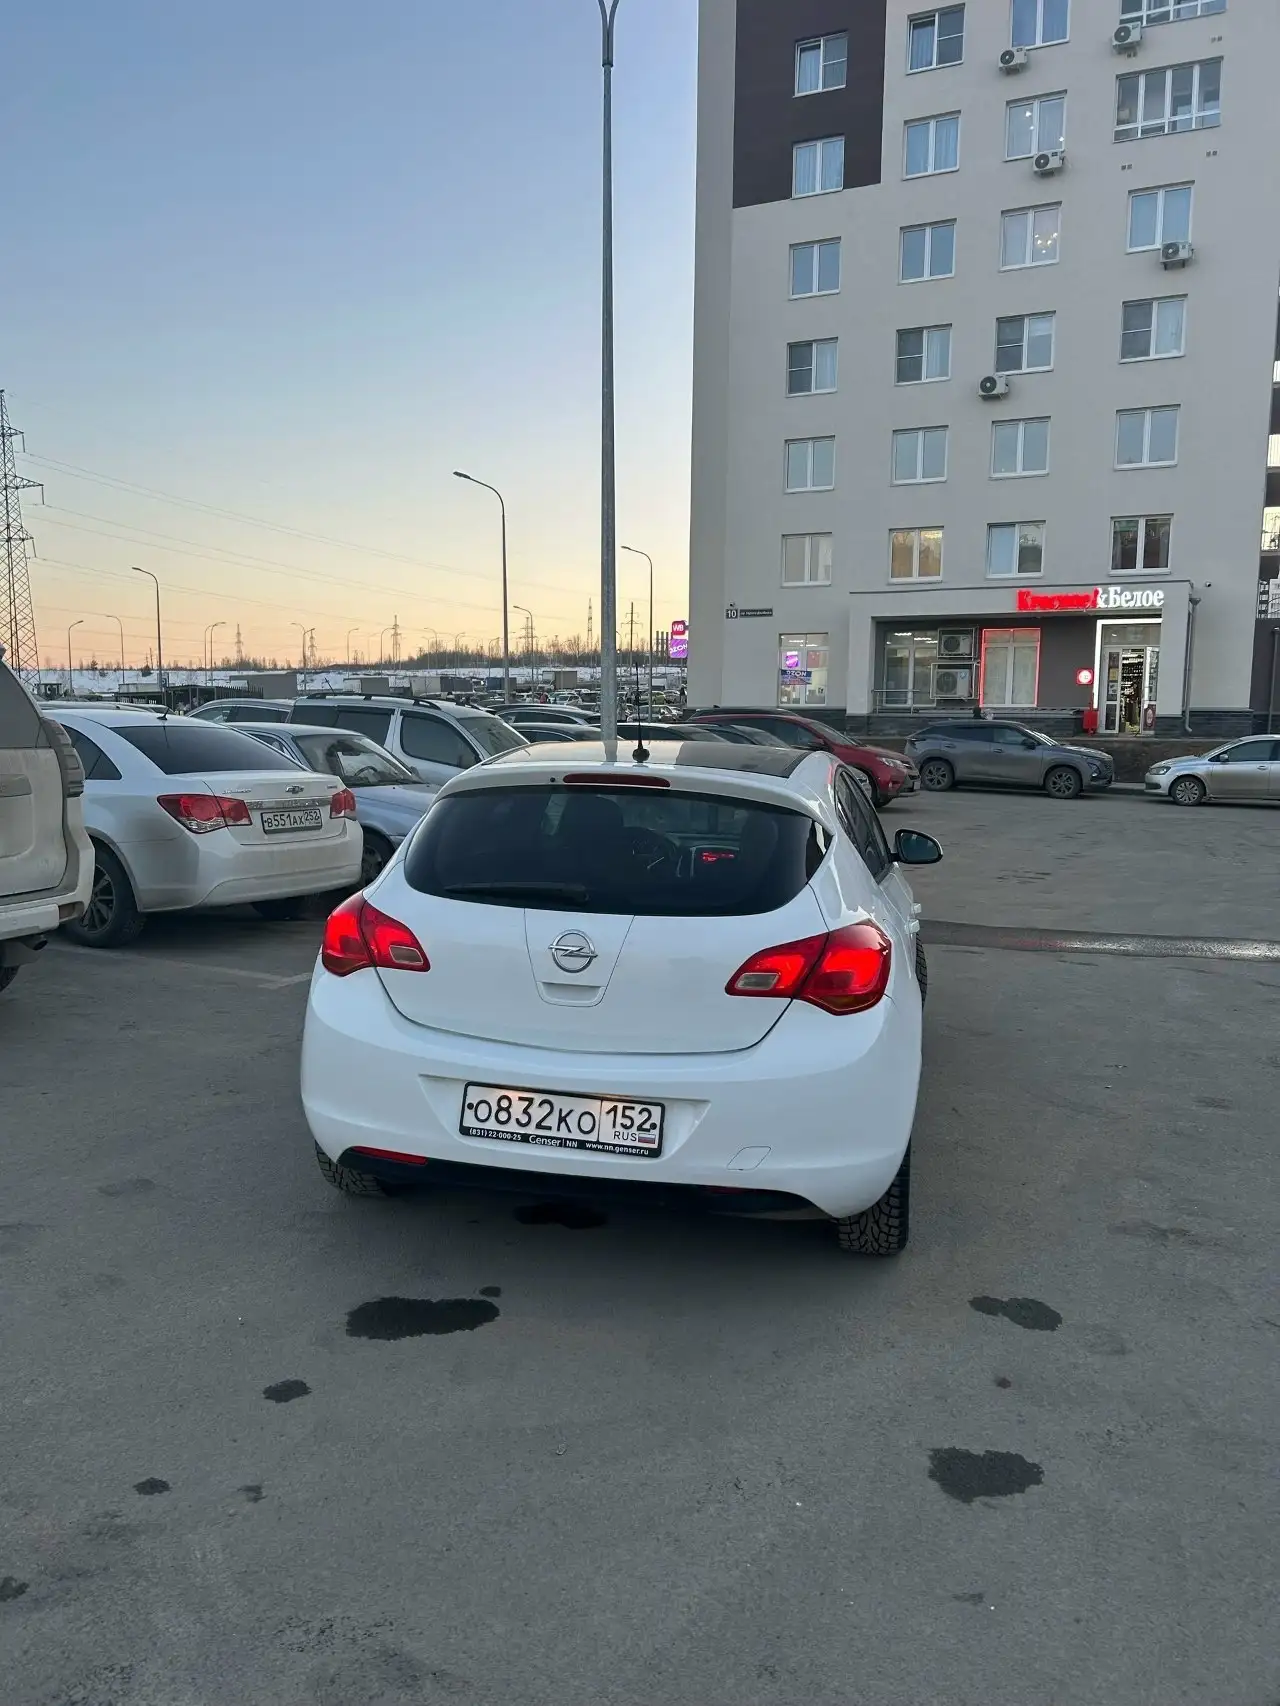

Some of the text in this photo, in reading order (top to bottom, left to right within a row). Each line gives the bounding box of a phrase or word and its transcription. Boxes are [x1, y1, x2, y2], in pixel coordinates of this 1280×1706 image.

[728, 610, 737, 618] 10
[672, 624, 684, 632] WB
[606, 1104, 652, 1132] 152
[469, 1127, 487, 1137] (831)
[529, 1135, 561, 1147] Genser
[566, 1140, 578, 1148] NN
[586, 1142, 649, 1155] www.nn.genser.ru
[613, 1131, 637, 1142] RUS
